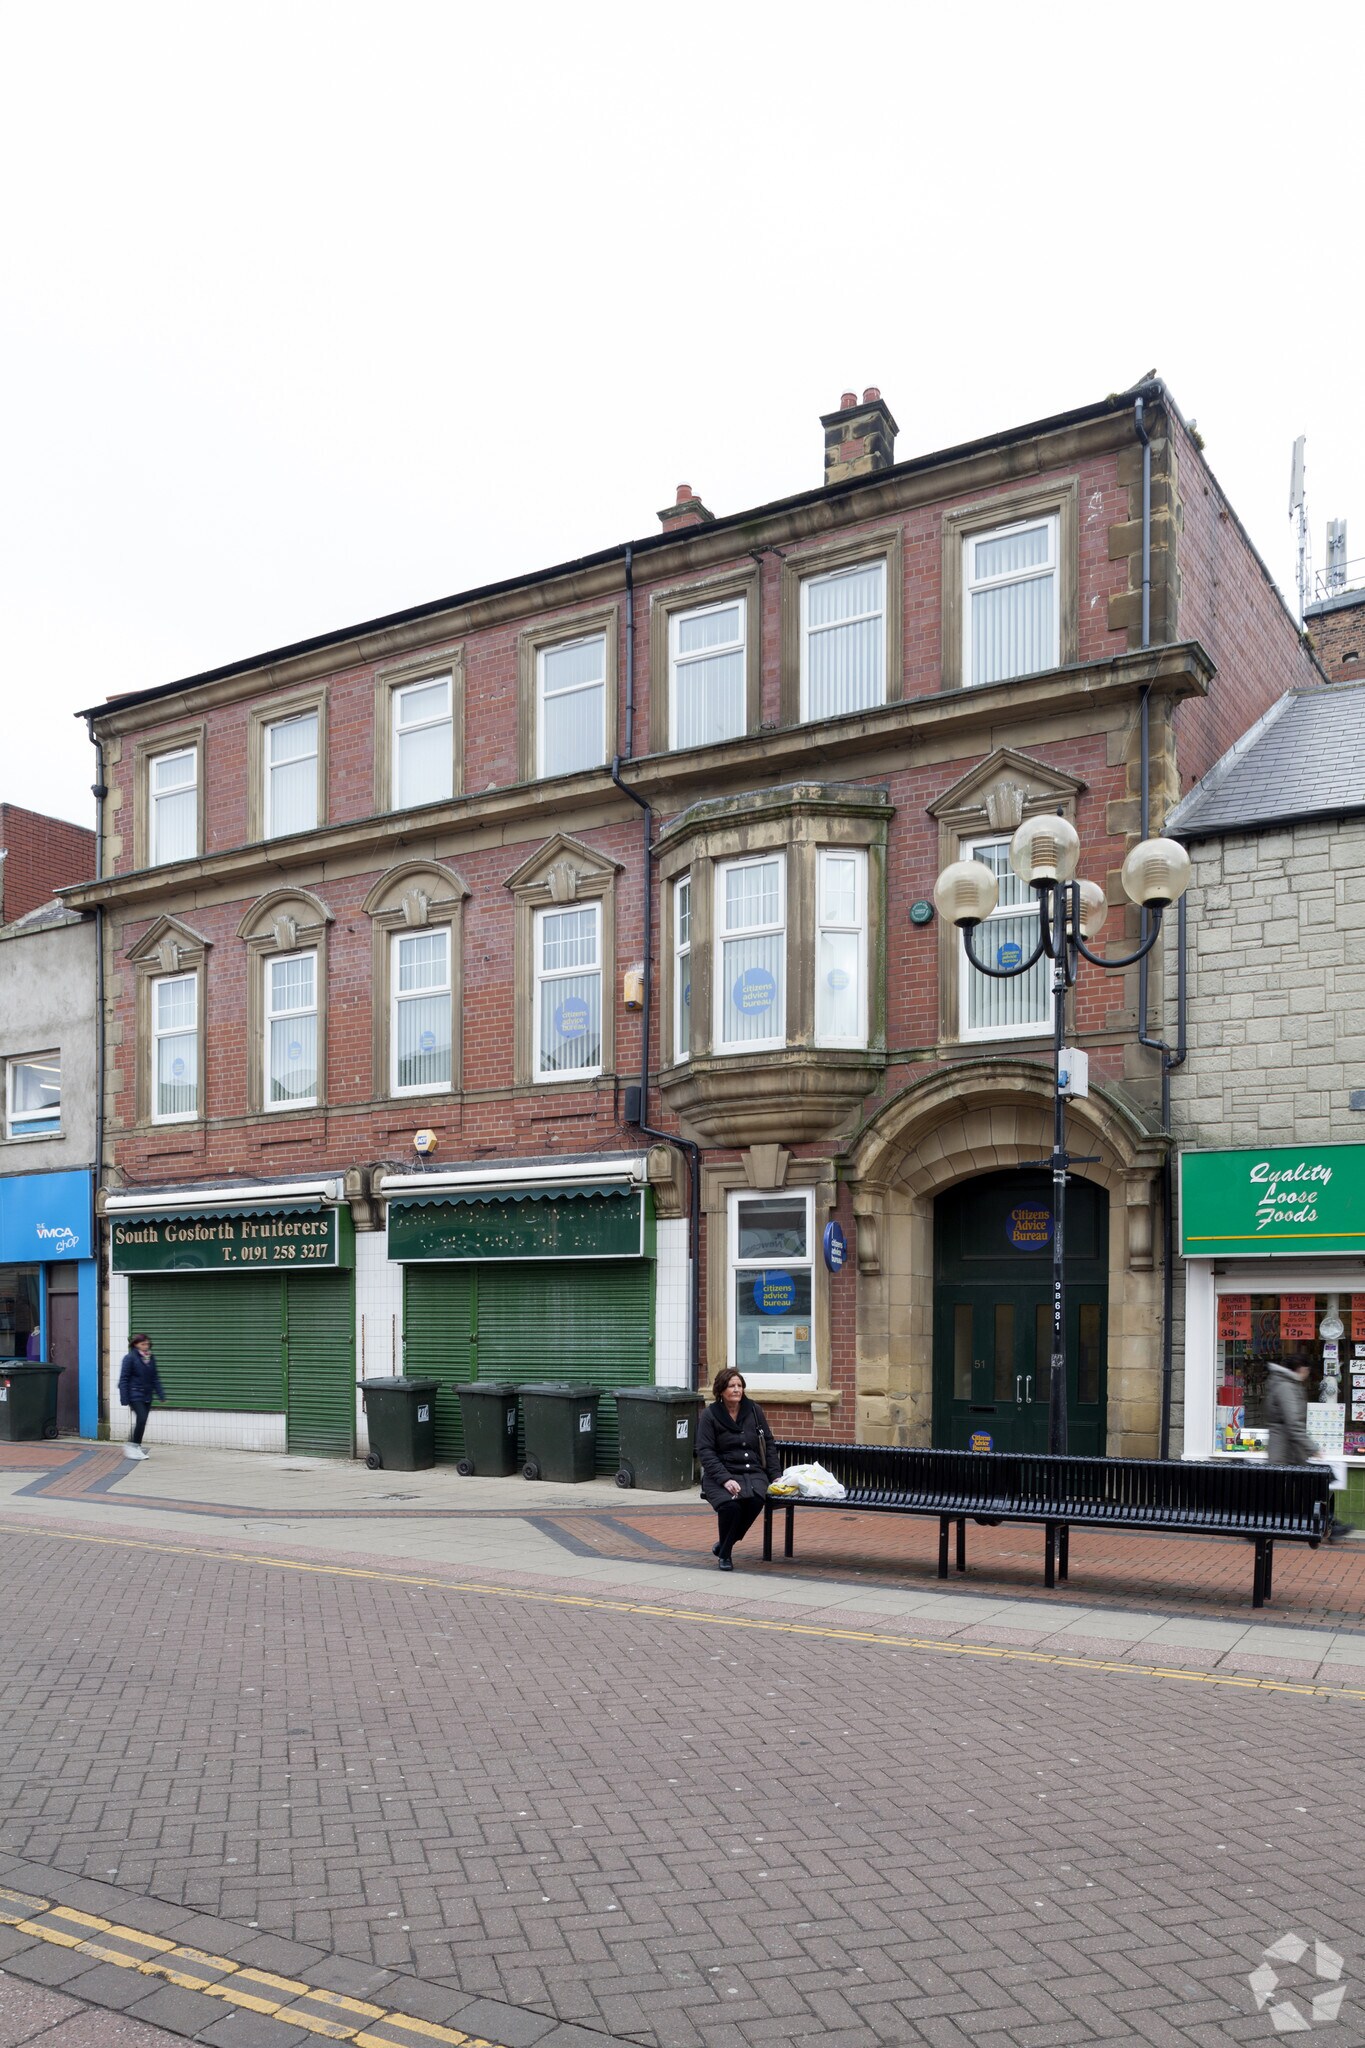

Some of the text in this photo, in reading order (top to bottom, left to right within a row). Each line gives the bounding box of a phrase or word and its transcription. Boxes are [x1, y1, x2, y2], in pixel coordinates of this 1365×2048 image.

[742, 984, 772, 992] citizens
[742, 992, 768, 1000] advice
[743, 1000, 771, 1008] bureau
[1250, 1162, 1332, 1186] Quality
[1258, 1182, 1318, 1206] Loose
[1011, 1209, 1050, 1220] Citizens
[1255, 1205, 1318, 1230] Foods
[1014, 1220, 1046, 1230] Advice
[116, 1219, 328, 1245] South Gosforth Fruiterers
[1012, 1230, 1048, 1241] Bureau
[222, 1244, 328, 1260] T. 0191 258 3217
[832, 1248, 842, 1256] advice
[832, 1256, 842, 1264] bureau
[1285, 1329, 1303, 1337] 12p
[974, 1360, 985, 1368] 51
